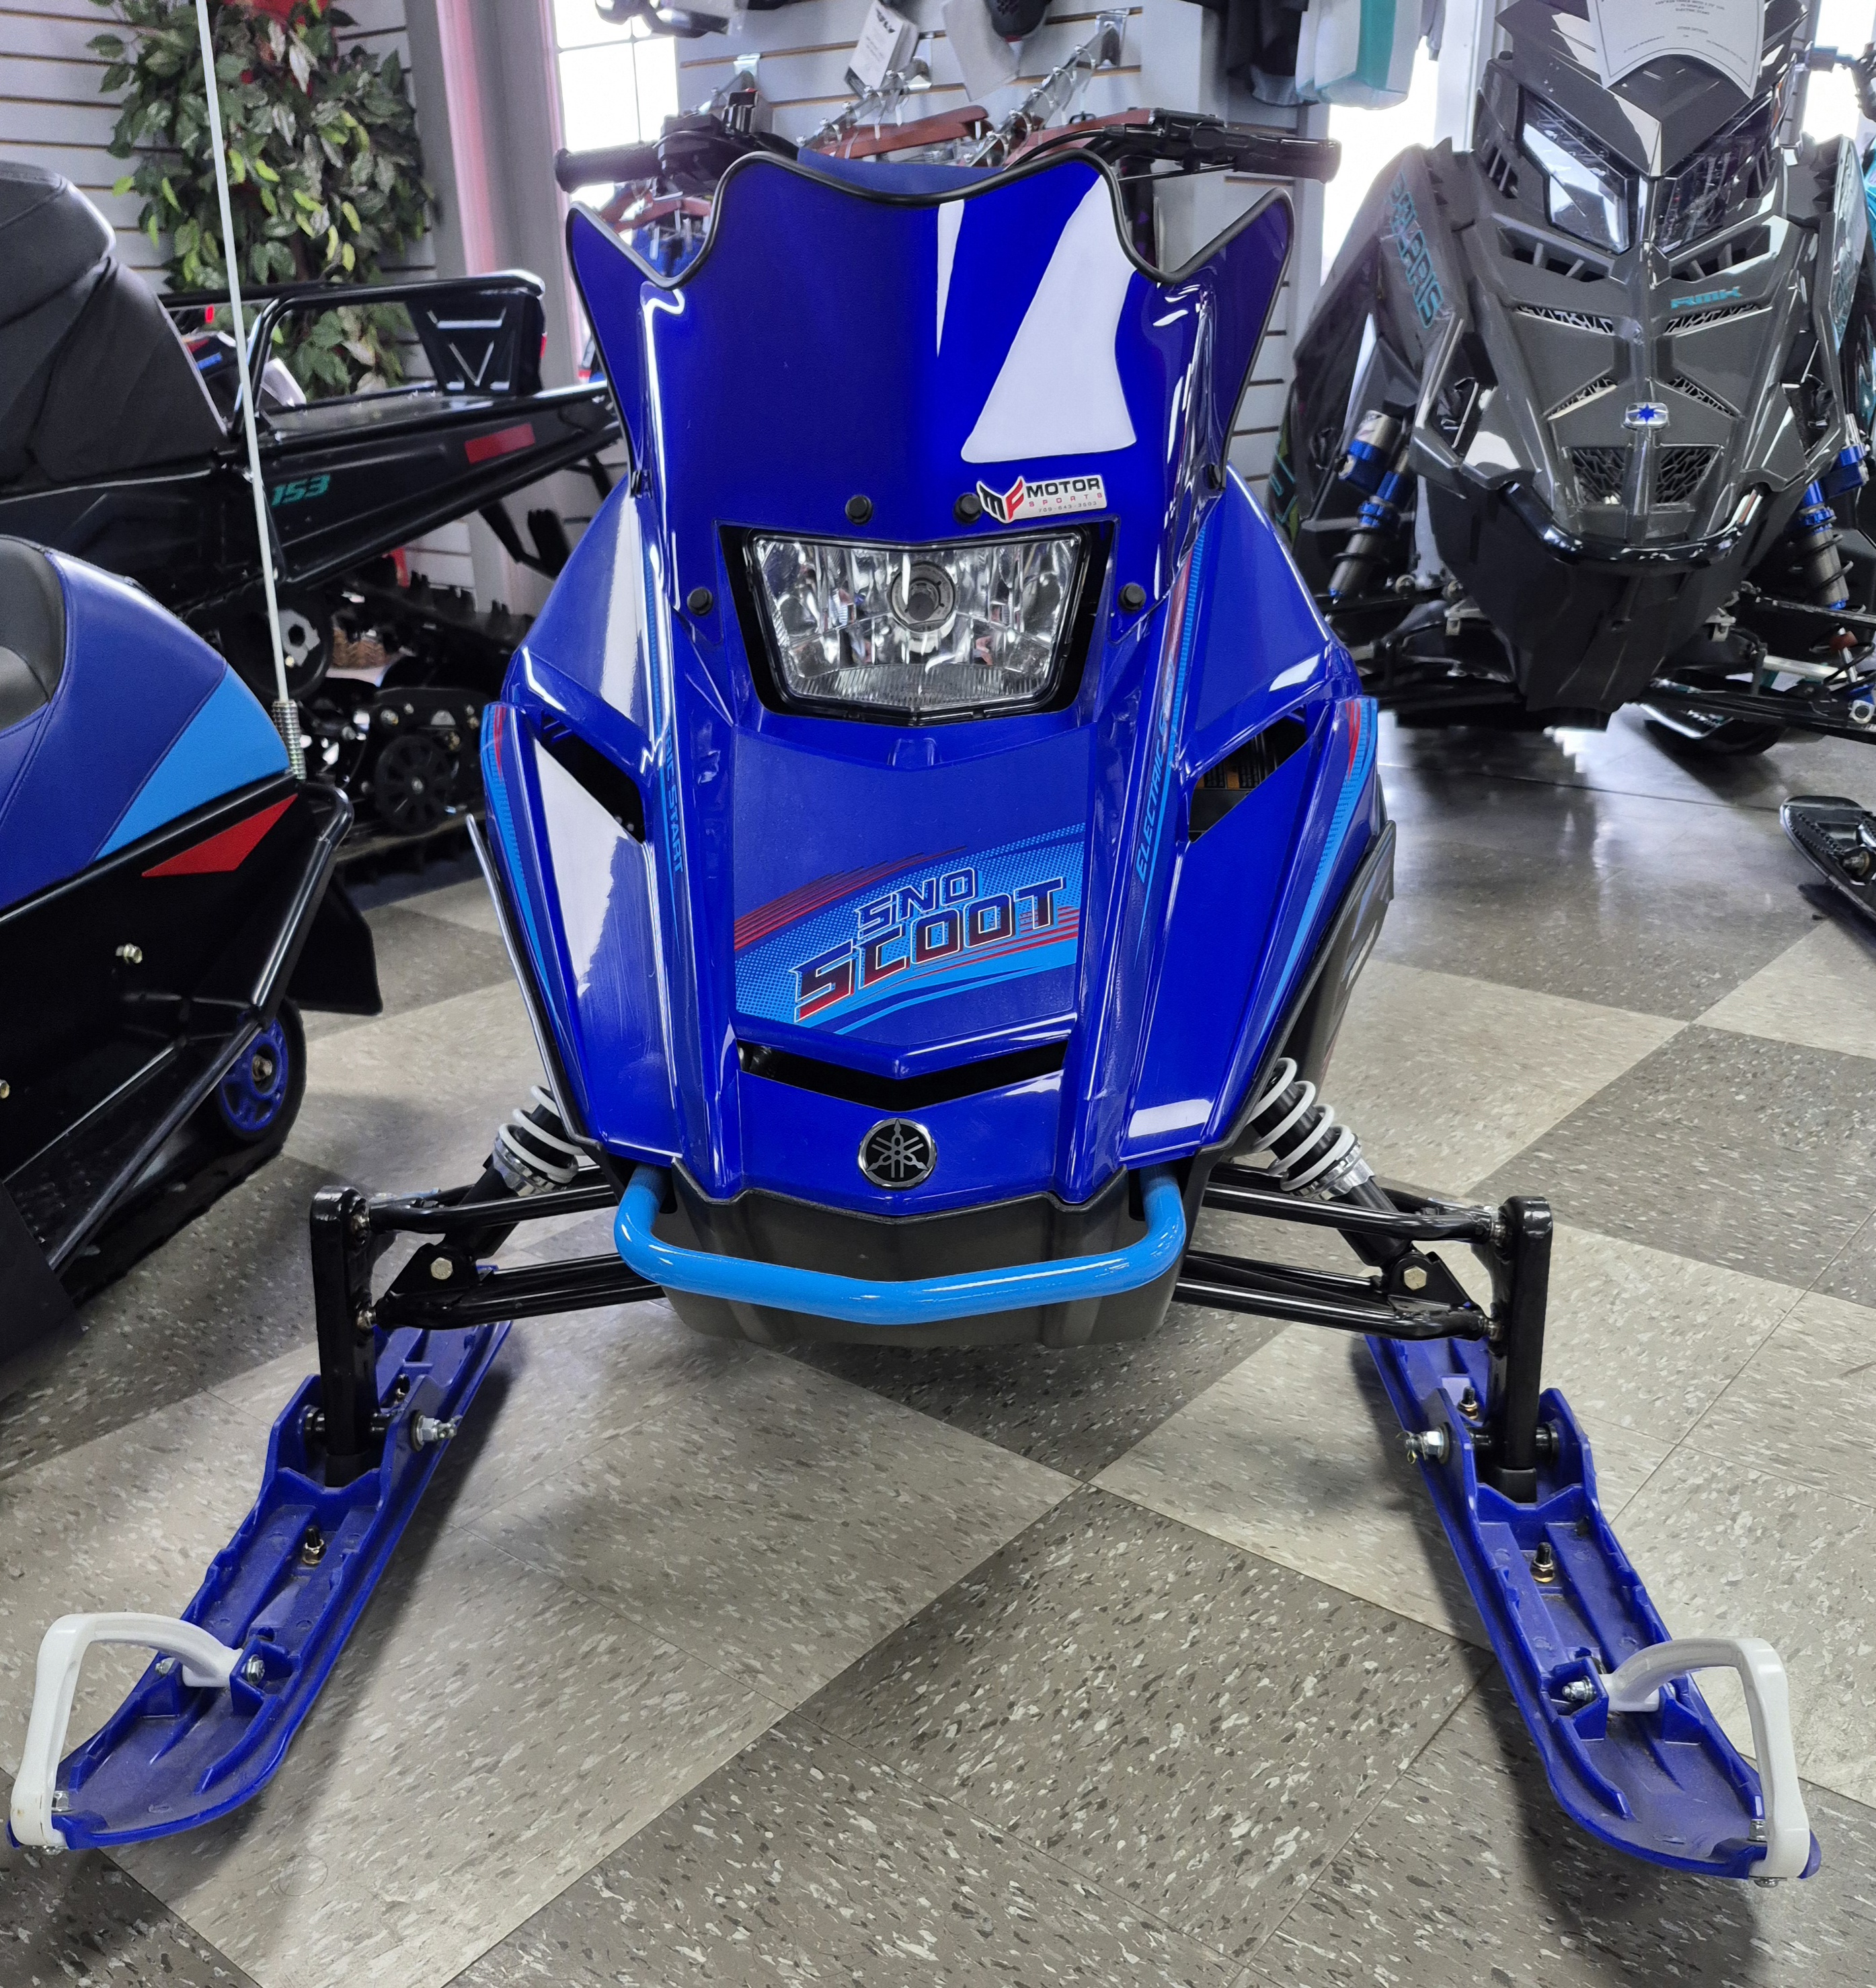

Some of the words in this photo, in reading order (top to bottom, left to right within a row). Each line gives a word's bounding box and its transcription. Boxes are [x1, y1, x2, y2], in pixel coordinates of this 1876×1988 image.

[271, 473, 331, 508] 153
[1026, 477, 1101, 498] MOTOR
[1028, 492, 1103, 508] SPORTS
[668, 784, 685, 873] START
[1136, 738, 1164, 884] ELECTRIC
[854, 866, 983, 940] SNO
[787, 876, 1064, 1024] SCOOT
